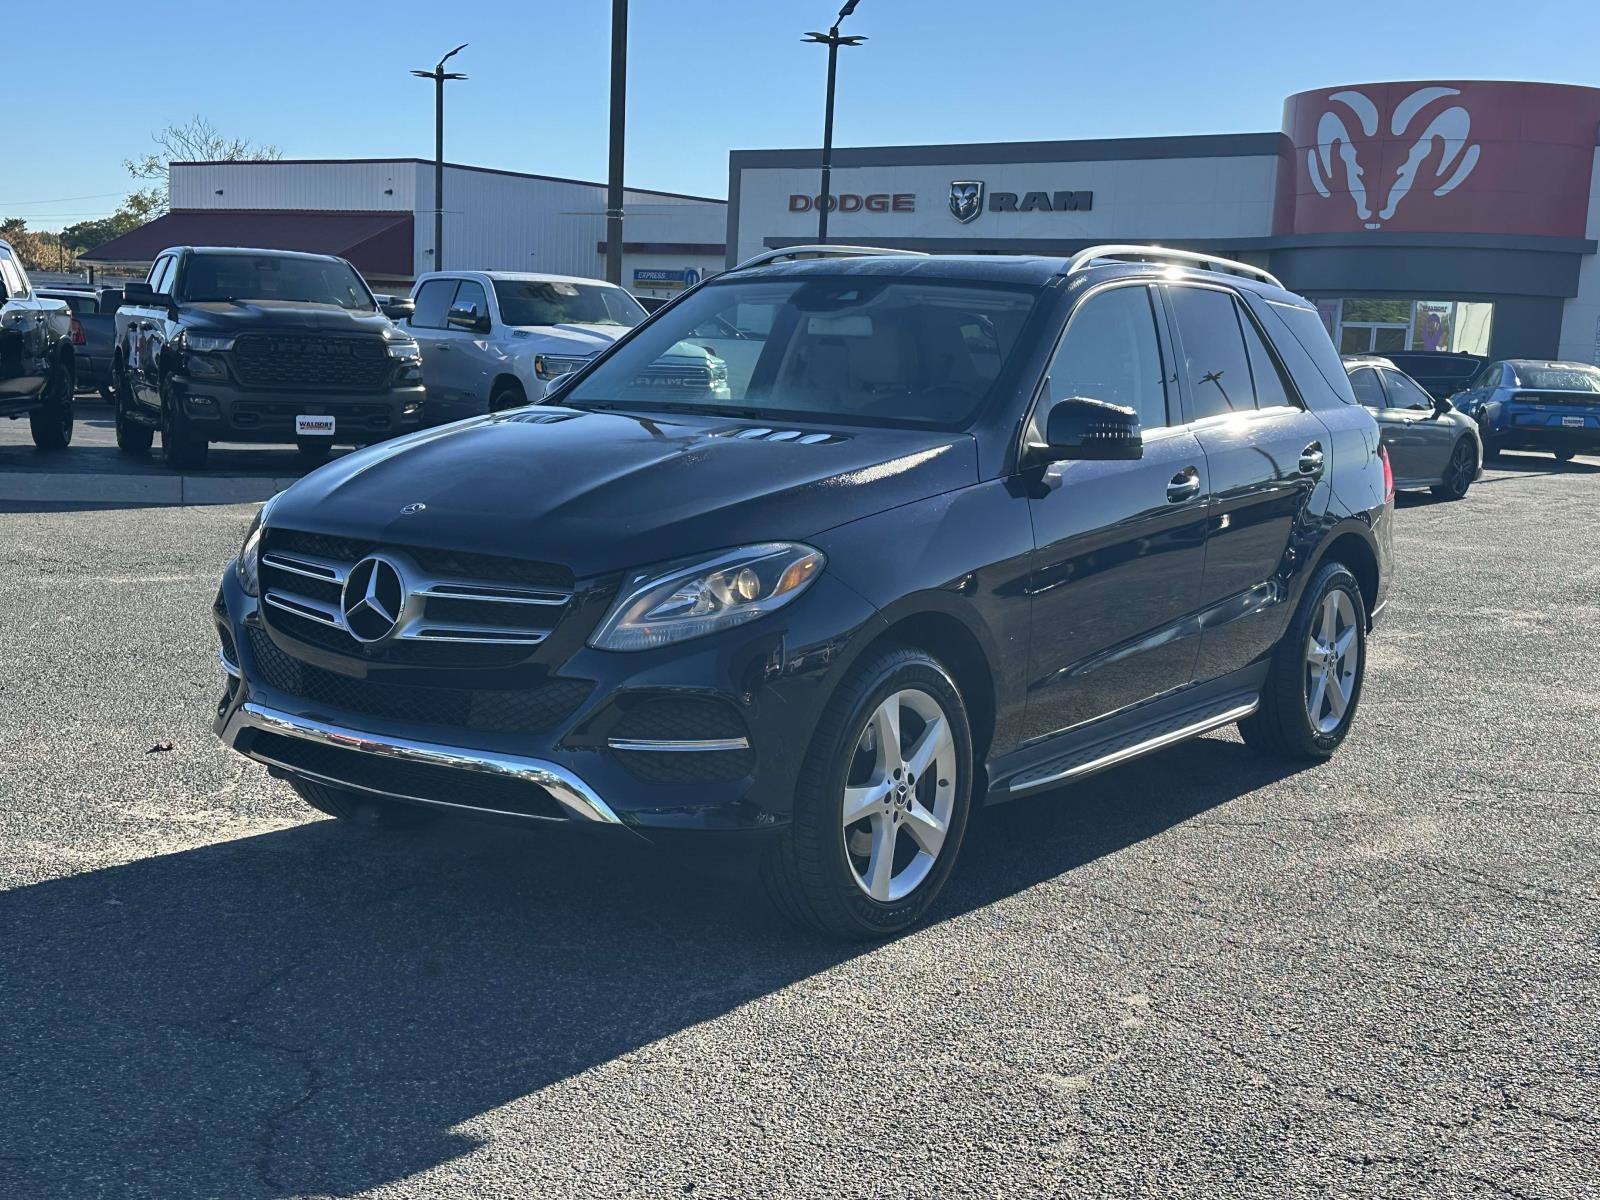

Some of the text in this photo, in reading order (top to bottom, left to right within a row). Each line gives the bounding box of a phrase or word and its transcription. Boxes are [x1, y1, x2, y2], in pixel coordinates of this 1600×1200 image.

[789, 193, 916, 213] DODGE
[988, 191, 1093, 212] RAM
[637, 271, 666, 279] EXPRESS
